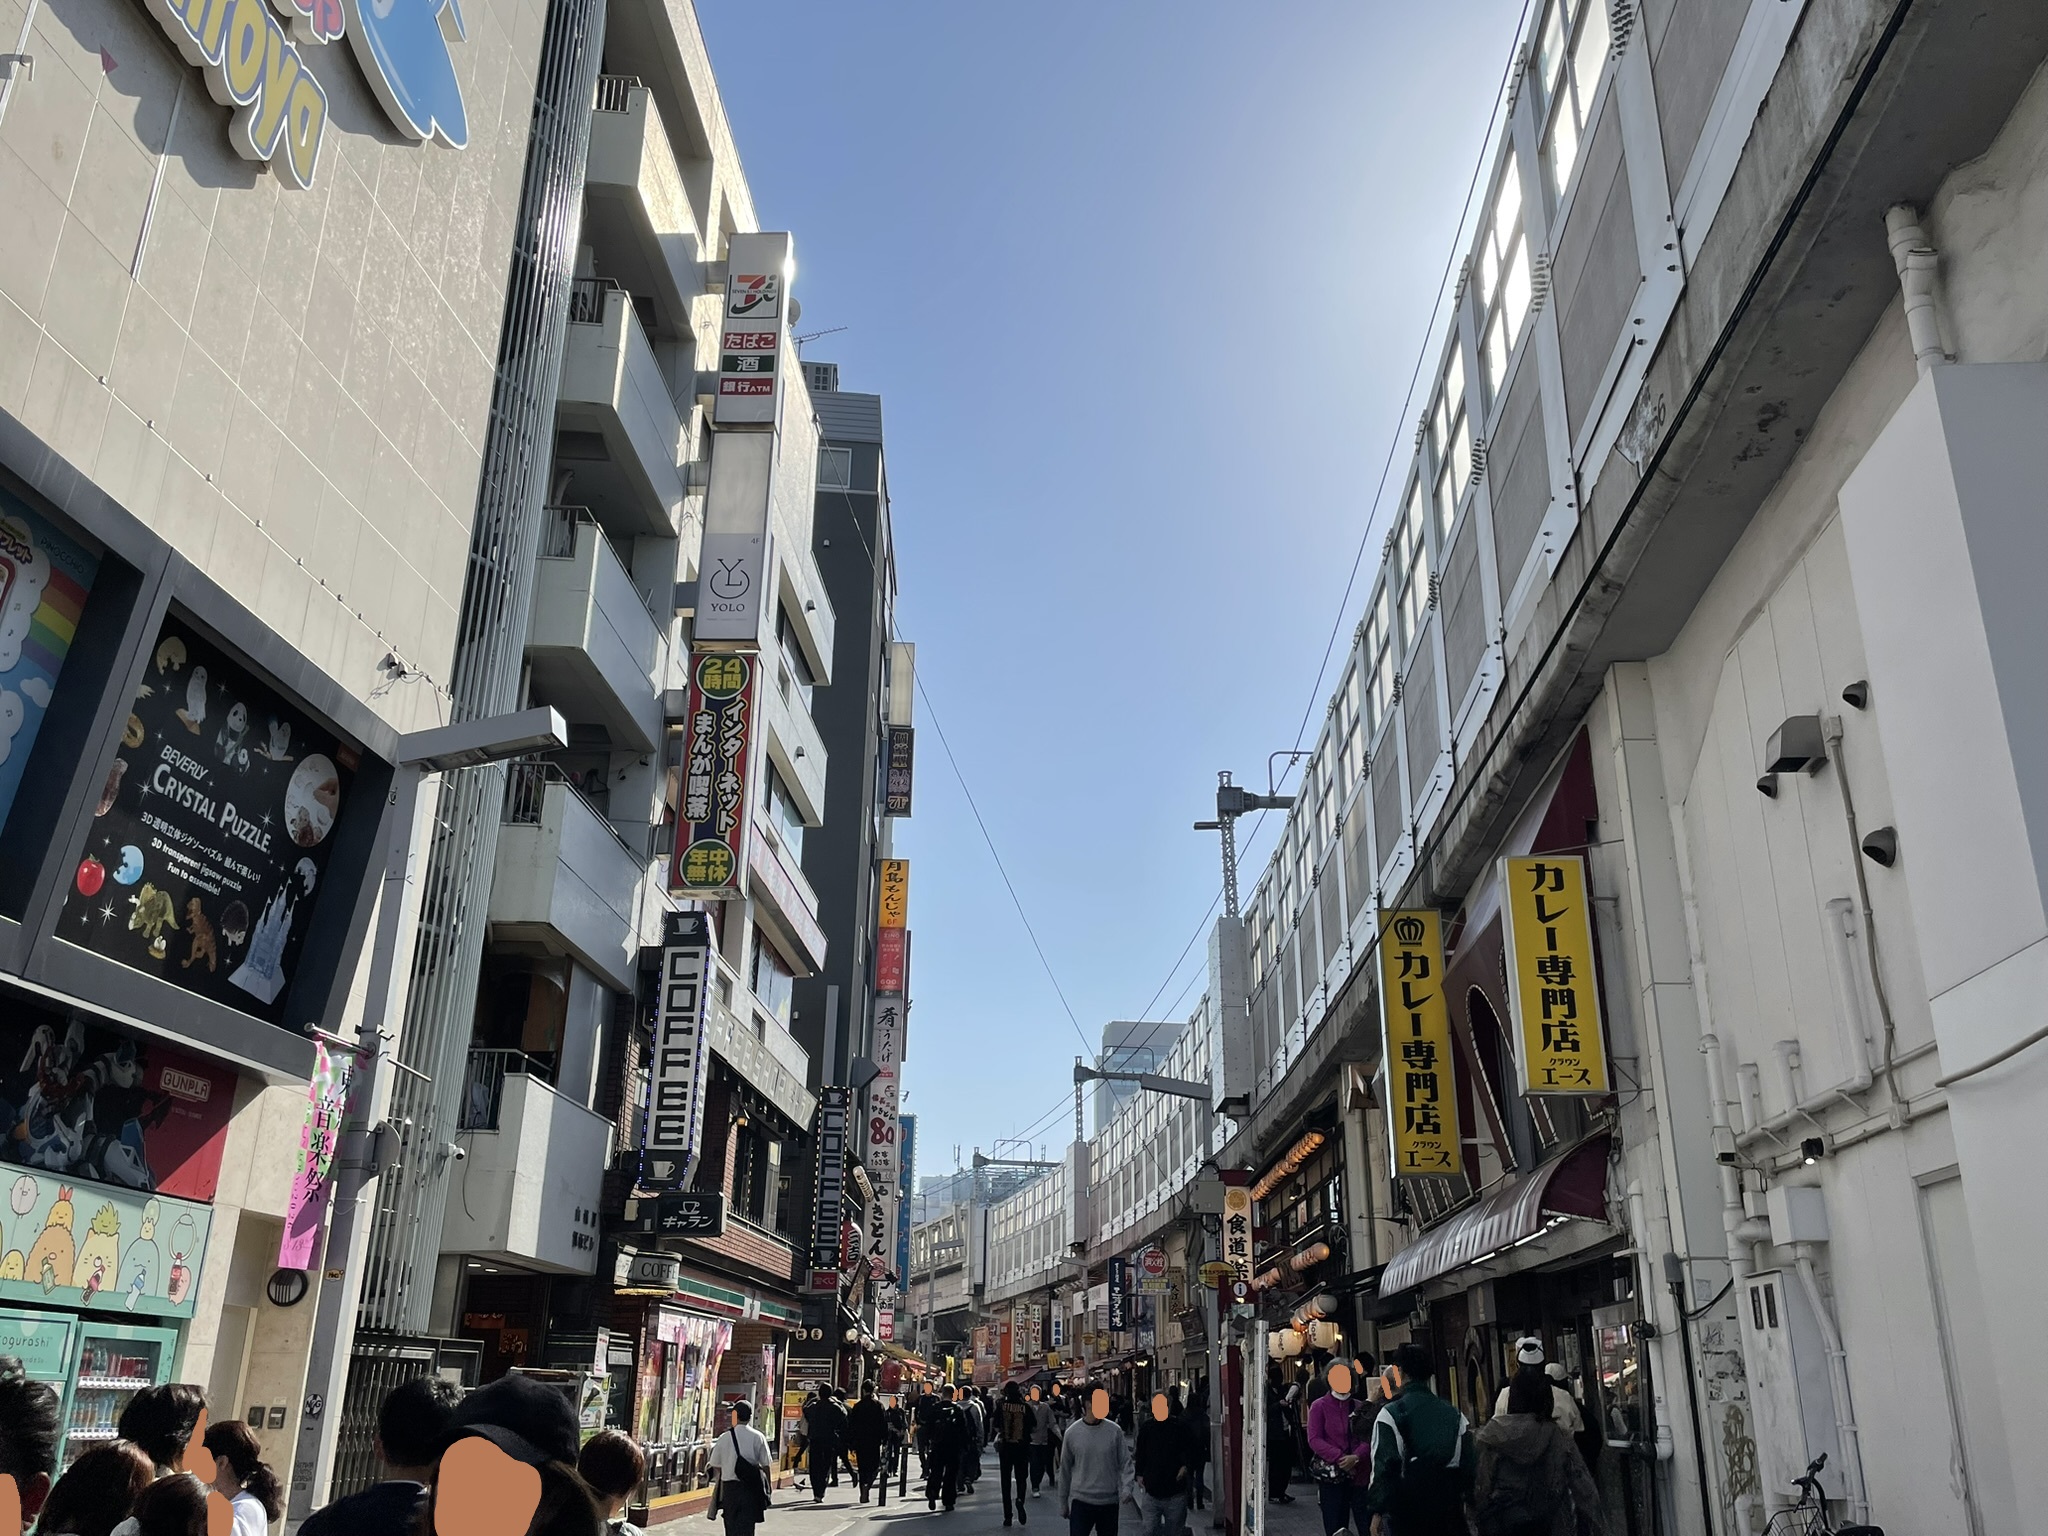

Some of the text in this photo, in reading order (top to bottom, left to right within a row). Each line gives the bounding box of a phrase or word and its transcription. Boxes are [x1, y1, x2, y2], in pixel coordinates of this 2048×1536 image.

[726, 334, 775, 350] たばこ
[736, 356, 760, 372] 酒
[722, 381, 771, 394] 銀行ATM
[750, 537, 761, 545] 4F
[40, 536, 85, 575] PINOCCHIO
[710, 603, 745, 612] YOLO
[704, 658, 741, 674] 24
[703, 673, 742, 690] 時間
[160, 744, 209, 781] BEVERLY
[686, 713, 713, 820] まんが喫茶
[719, 700, 746, 834] インターネット
[153, 763, 272, 854] CRYSTAL PUZZLE
[151, 837, 243, 892] 3D transparent jigsaw puzzle
[688, 848, 729, 866] 年中
[167, 861, 222, 896] Fun to assemble!
[686, 864, 728, 882] 無休
[884, 861, 904, 917] 月島もんじゃ
[1526, 863, 1580, 1053] カレー専門店
[653, 951, 700, 1146] COFFEE
[881, 1029, 894, 1064] うたげ
[1393, 951, 1440, 1135] カレー専門店
[1549, 1057, 1581, 1067] クラウン
[163, 1072, 208, 1098] GUNPLA
[1541, 1067, 1592, 1086] エース
[870, 1104, 896, 1121] やきとん
[870, 1116, 894, 1145] 80
[302, 1095, 336, 1204] 音楽祭
[1411, 1140, 1442, 1150] クラウン
[1404, 1150, 1452, 1168] エース
[816, 1110, 844, 1245] COFFEE
[662, 1215, 714, 1229] ギャラン
[868, 1184, 889, 1257] やきとん
[1226, 1212, 1250, 1280] 食道楽
[813, 1276, 836, 1285] 宝くじ
[0, 1335, 50, 1350] ogurashi
